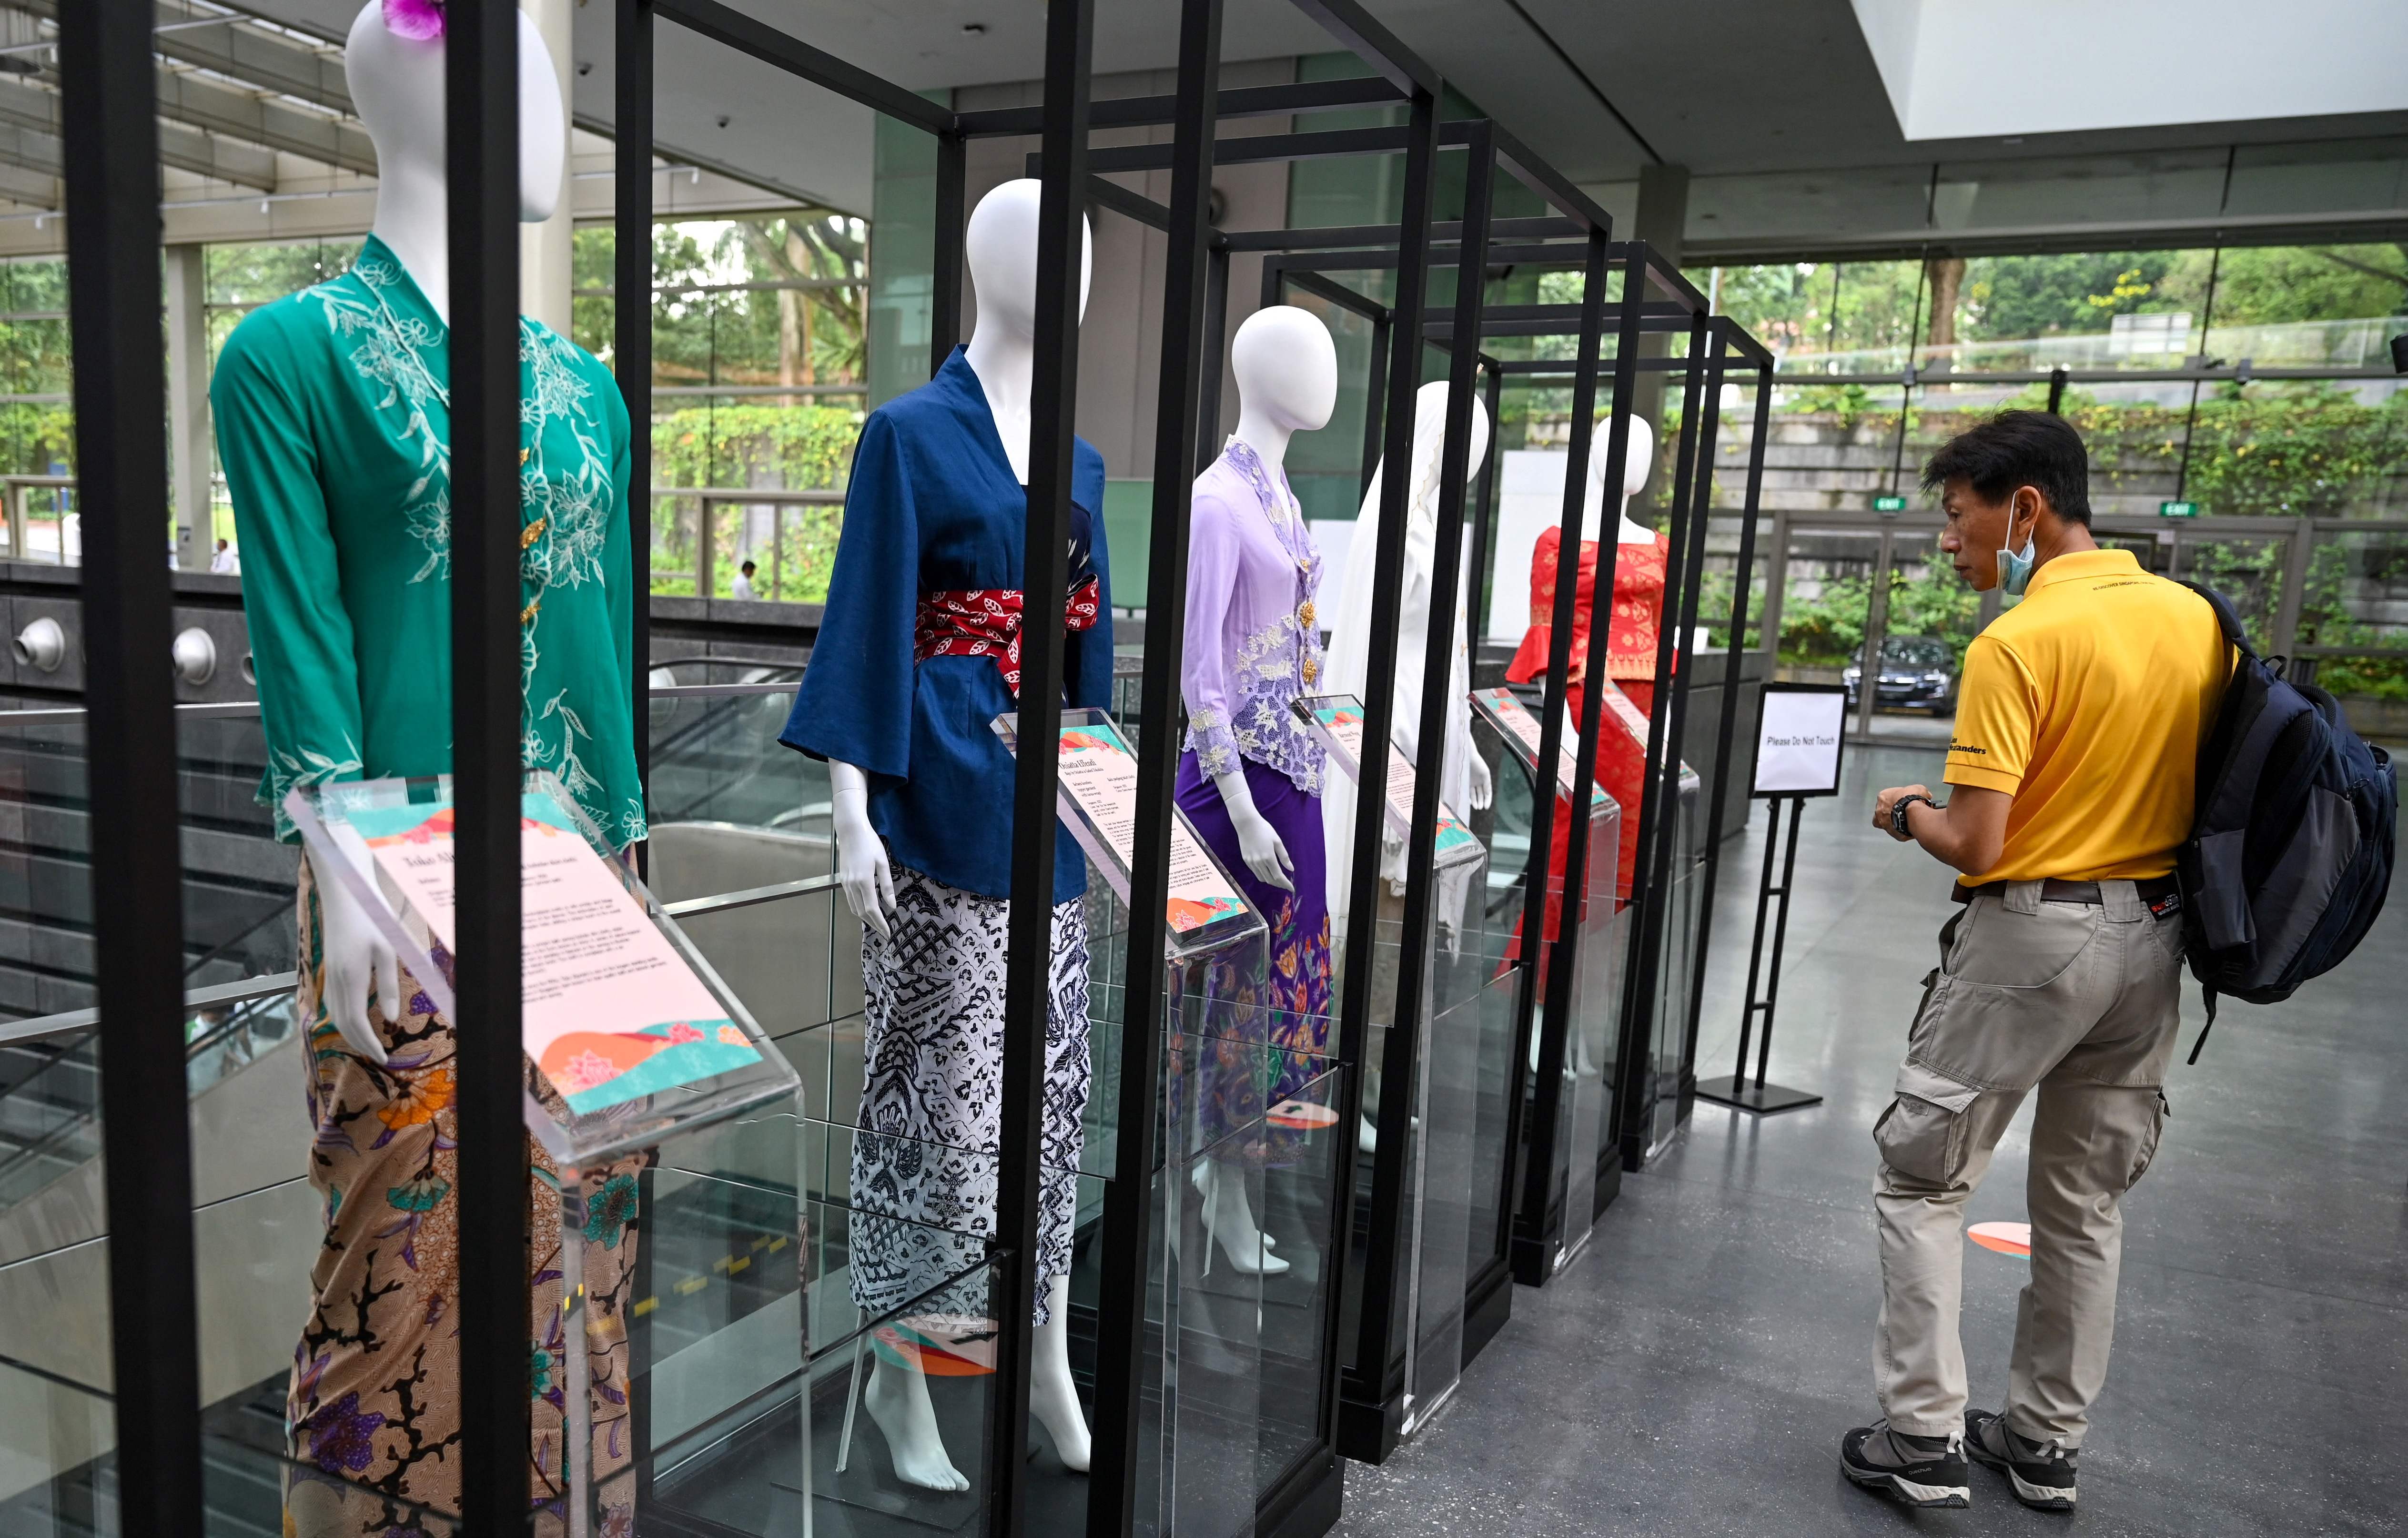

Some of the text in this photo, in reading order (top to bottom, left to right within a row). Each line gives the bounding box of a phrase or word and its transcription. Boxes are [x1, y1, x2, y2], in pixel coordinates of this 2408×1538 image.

[1878, 497, 1900, 511] EXIT
[2165, 503, 2190, 516] EXIT
[1767, 736, 1835, 746] Please Do Not Touch
[1077, 758, 1096, 767] Effendi
